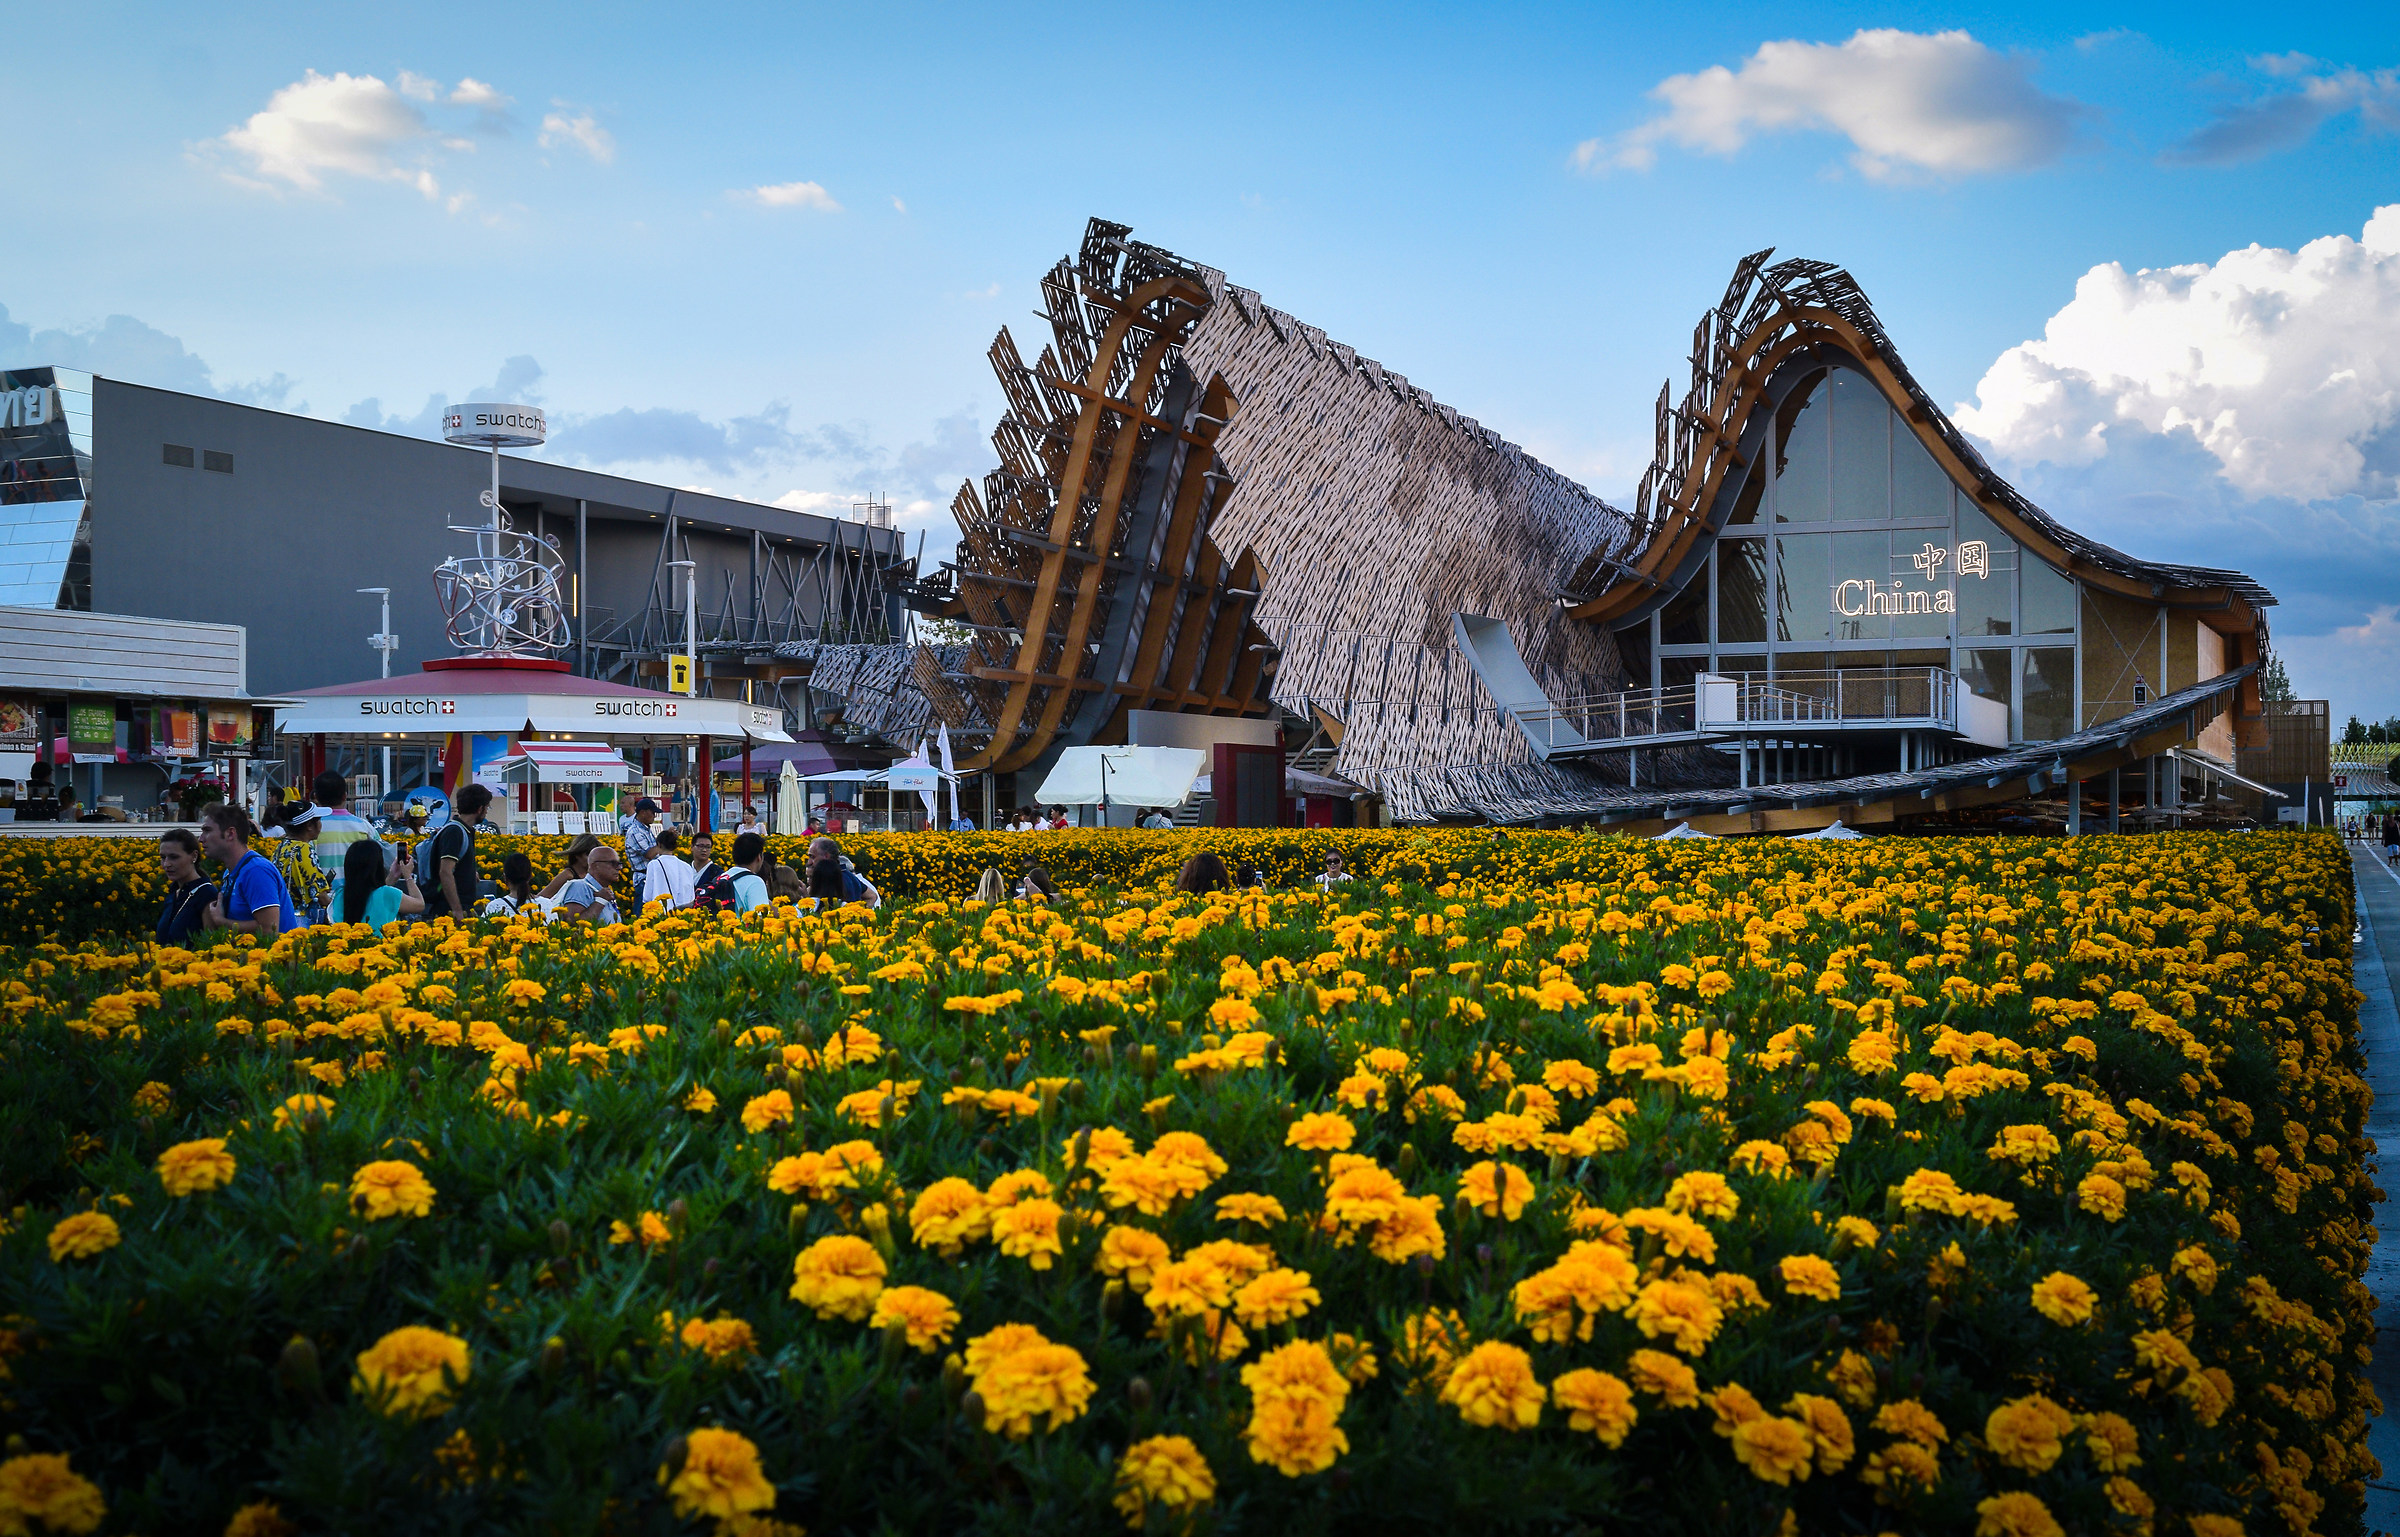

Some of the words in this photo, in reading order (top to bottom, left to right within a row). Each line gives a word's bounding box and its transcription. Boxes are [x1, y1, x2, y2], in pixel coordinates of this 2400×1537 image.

[476, 412, 541, 431] swatch
[1912, 540, 1989, 581] 中国
[1835, 579, 1956, 616] China
[361, 698, 438, 715] swatch
[595, 701, 663, 716] swatch
[565, 769, 597, 777] swatch
